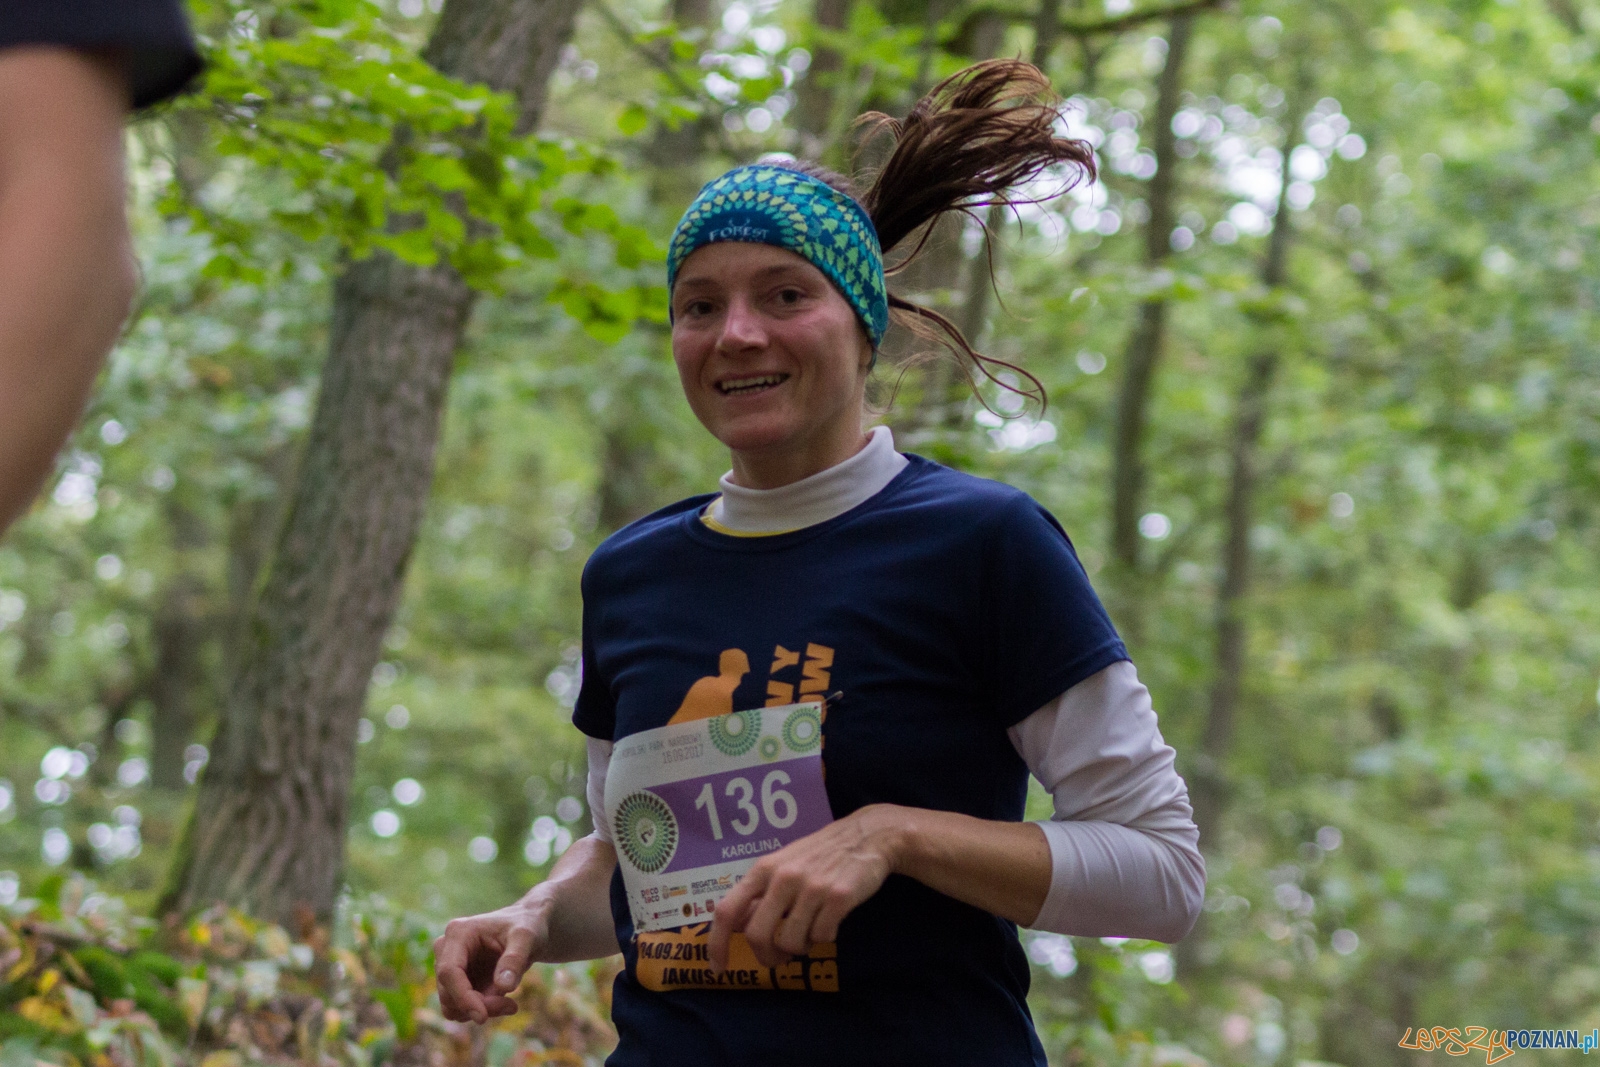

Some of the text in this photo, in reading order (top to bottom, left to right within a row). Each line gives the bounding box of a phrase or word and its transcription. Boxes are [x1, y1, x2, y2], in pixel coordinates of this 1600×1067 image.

[694, 769, 798, 840] 136
[722, 837, 782, 859] KAROLINA
[691, 878, 718, 889] REGATTA
